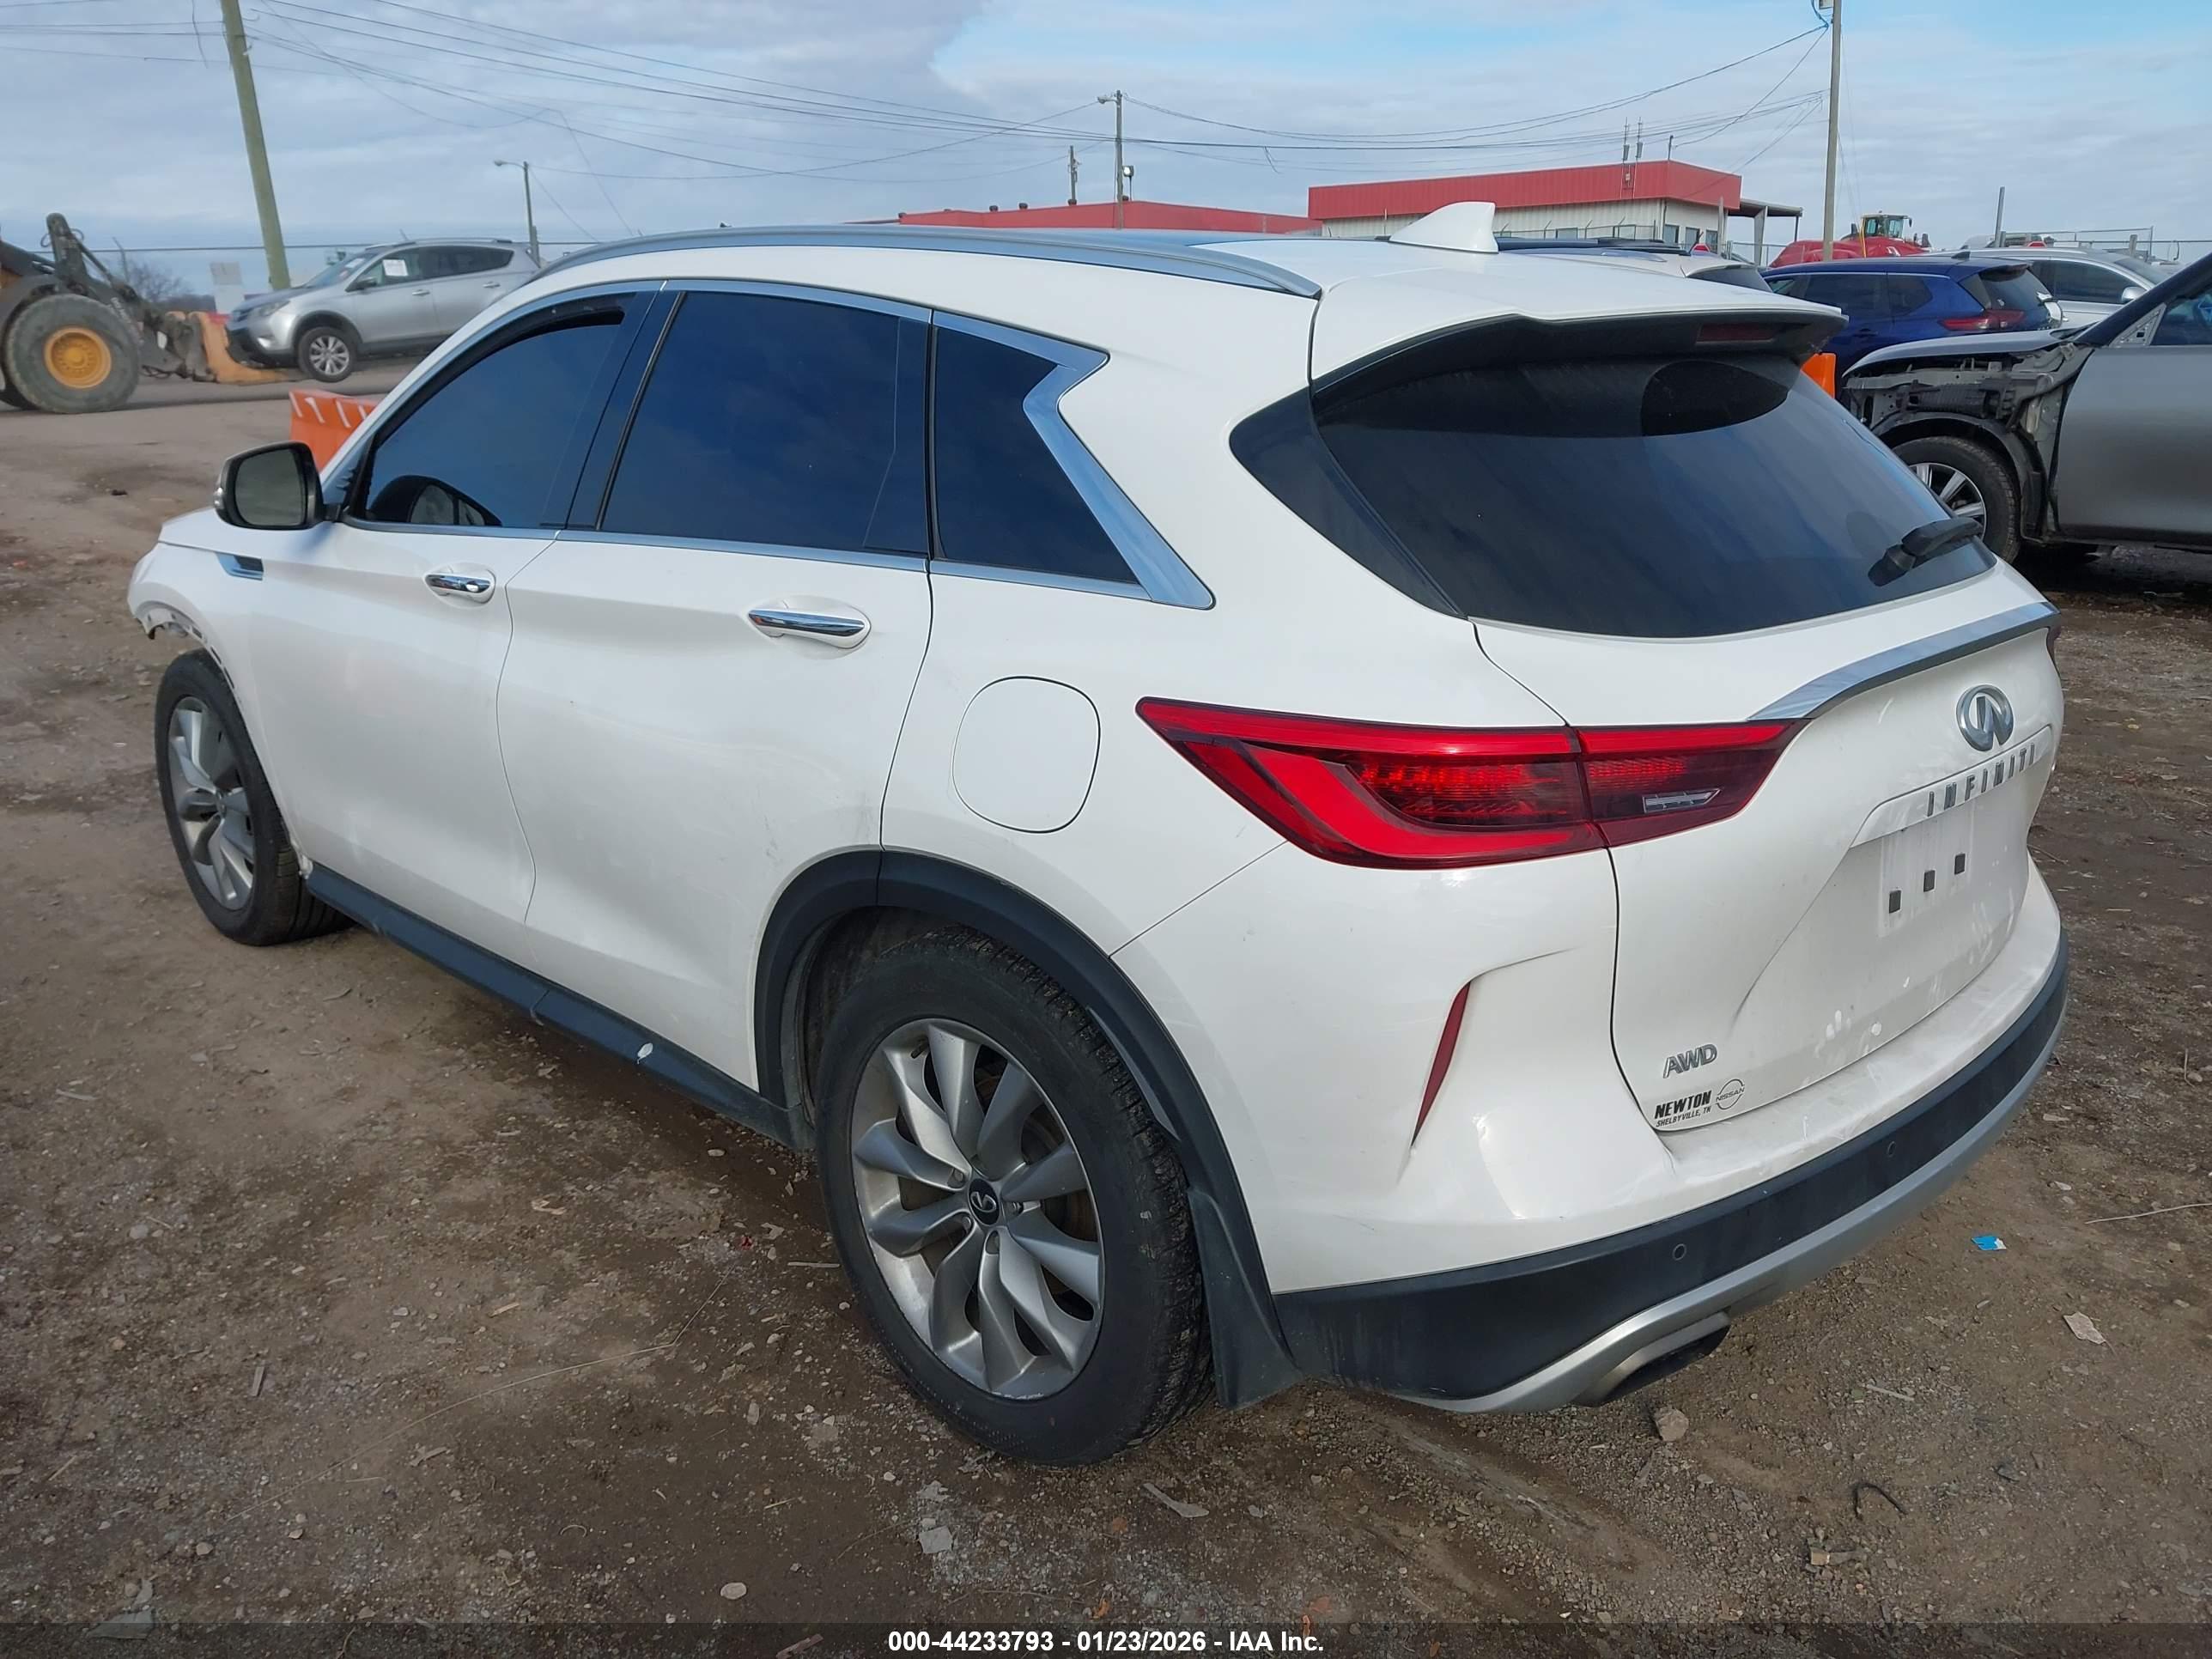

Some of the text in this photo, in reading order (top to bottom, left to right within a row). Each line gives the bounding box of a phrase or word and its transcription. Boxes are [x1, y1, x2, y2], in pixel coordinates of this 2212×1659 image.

[1927, 743, 2035, 817] INFINITI
[1662, 1043, 1717, 1079] AWD
[1654, 1090, 1712, 1119] NEWTON
[1716, 1087, 1745, 1102] NISSAN
